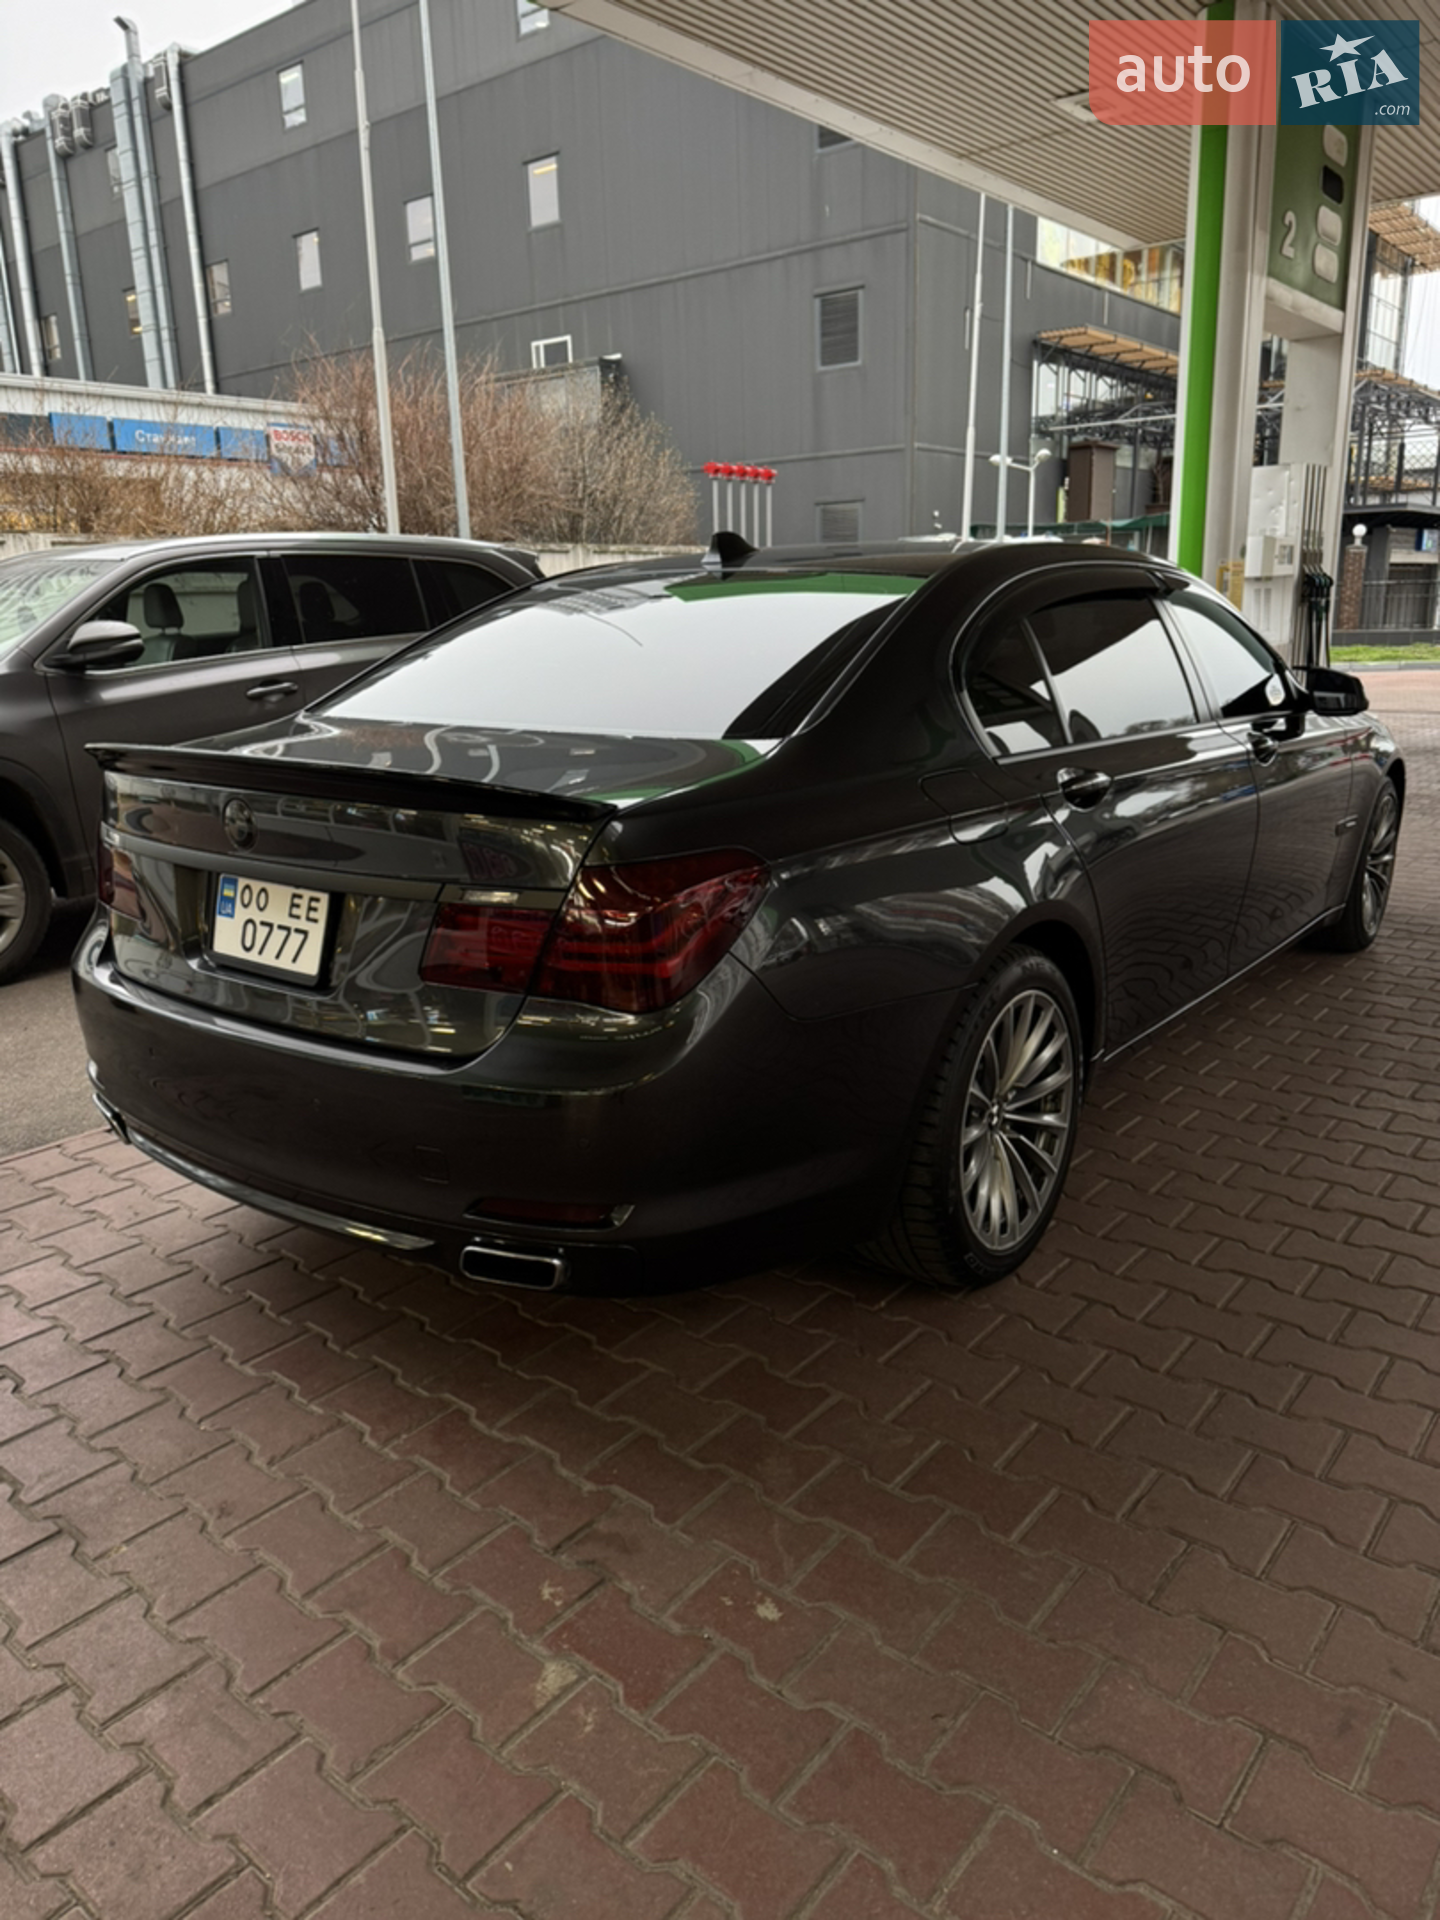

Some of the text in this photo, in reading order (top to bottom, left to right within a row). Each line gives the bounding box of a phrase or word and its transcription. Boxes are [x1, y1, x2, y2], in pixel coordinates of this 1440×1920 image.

[1280, 209, 1296, 260] 2
[288, 893, 321, 924] EE
[241, 918, 309, 964] 0777
